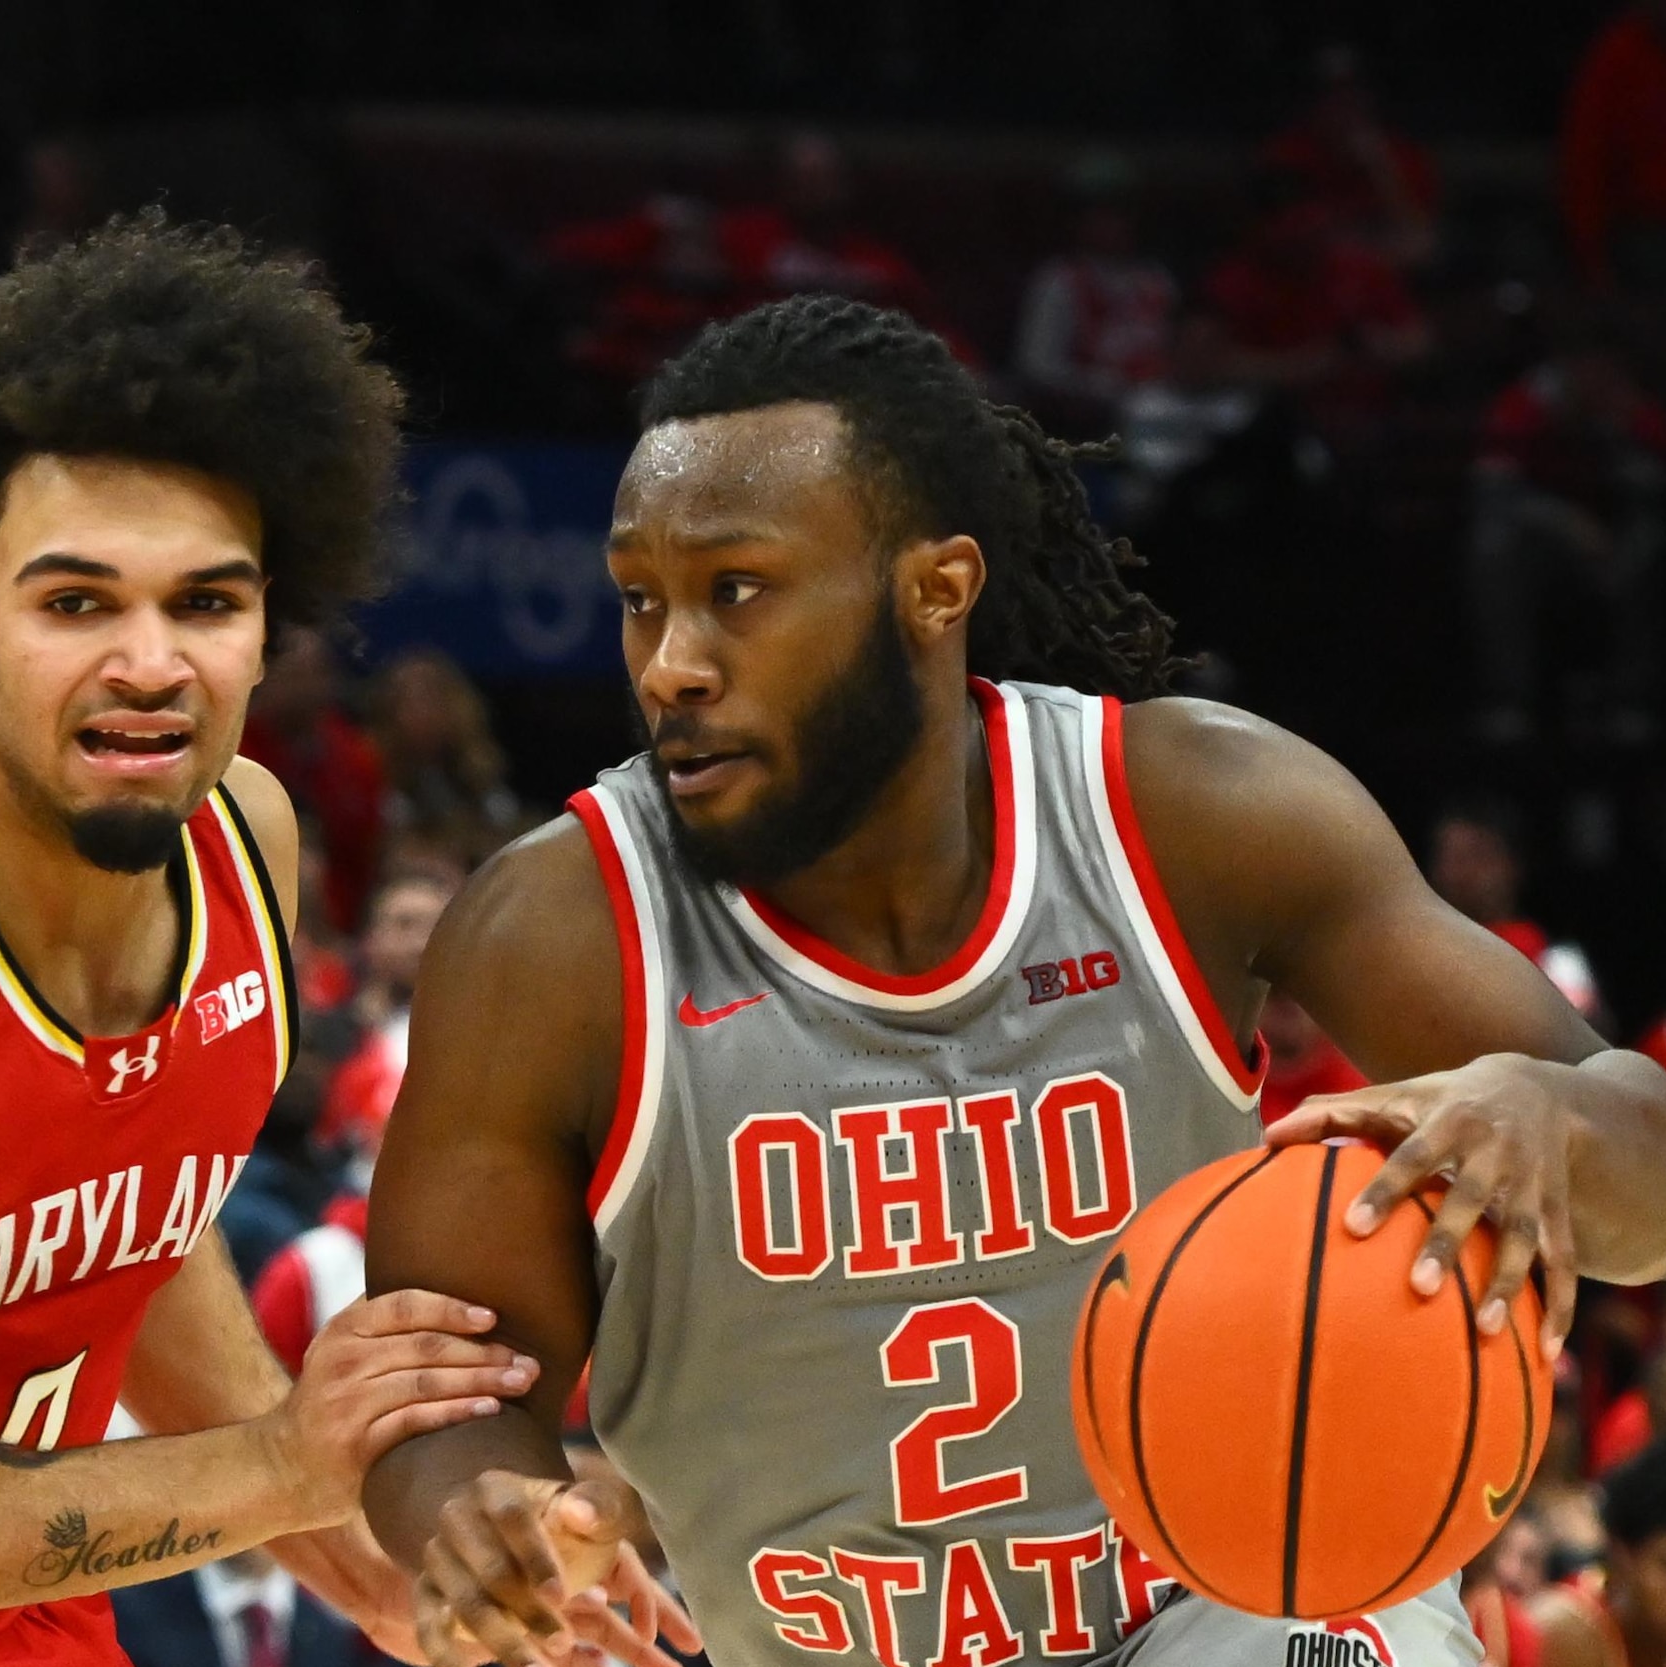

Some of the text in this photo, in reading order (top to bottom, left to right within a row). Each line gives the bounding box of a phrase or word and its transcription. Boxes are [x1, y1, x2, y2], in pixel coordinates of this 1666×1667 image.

[728, 1071, 1137, 1282] OHIO
[879, 1296, 1029, 1528] 2
[22, 1517, 223, 1587] Heather
